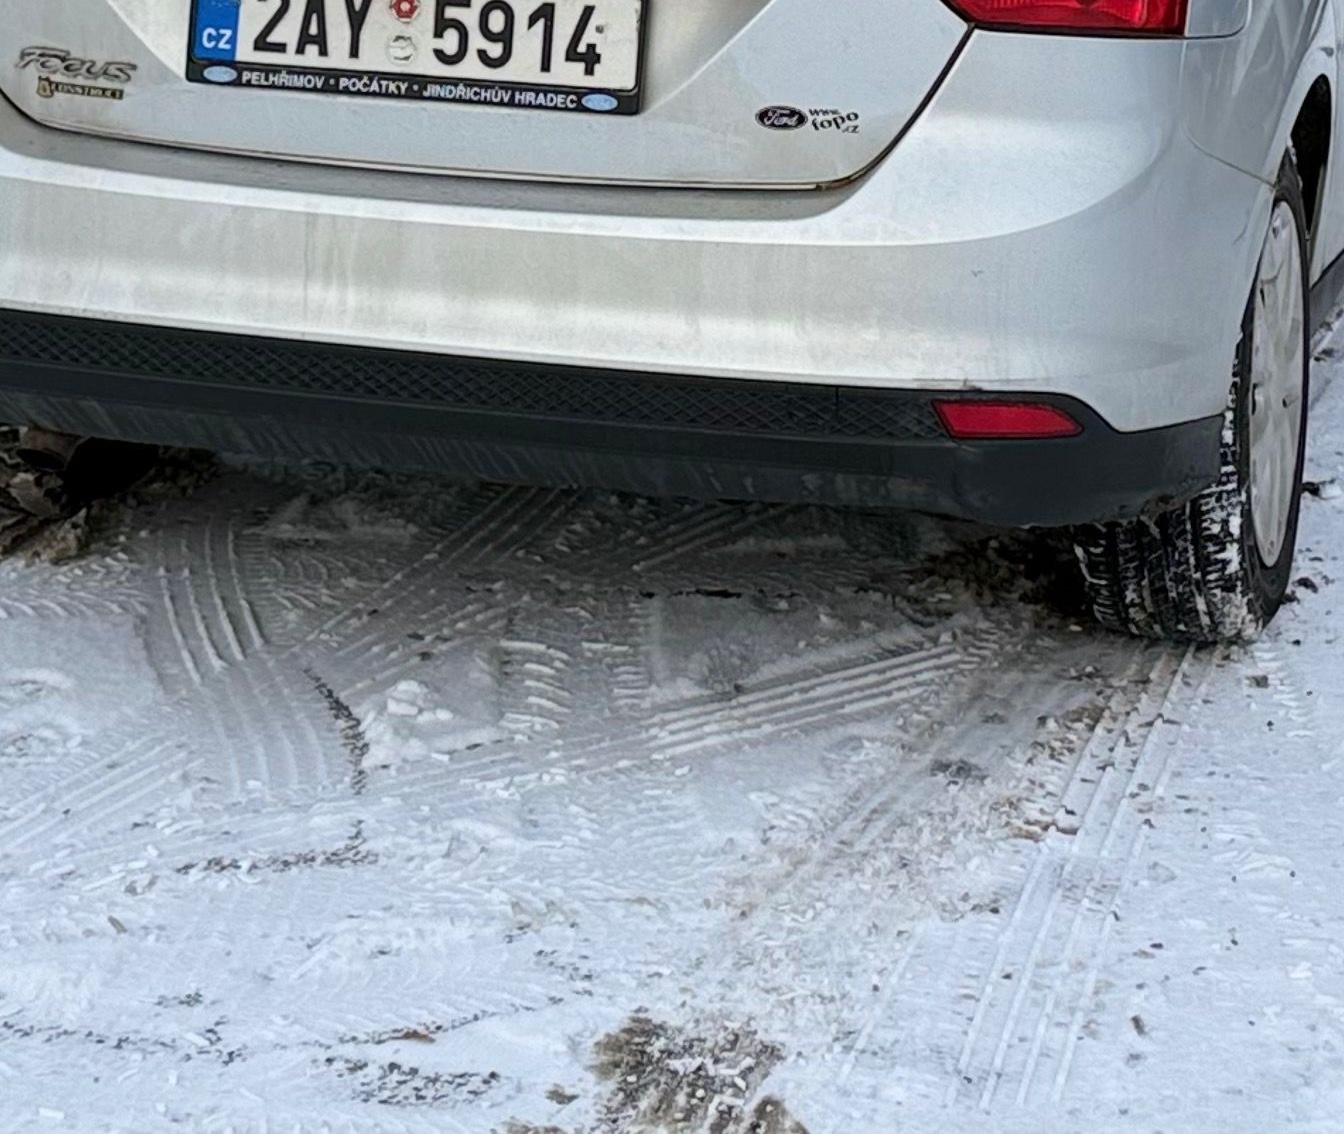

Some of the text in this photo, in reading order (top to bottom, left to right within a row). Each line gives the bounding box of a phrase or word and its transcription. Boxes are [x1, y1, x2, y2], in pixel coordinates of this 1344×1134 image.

[202, 26, 233, 50] CZ
[241, 69, 325, 89] PELHŘIMOV
[338, 75, 409, 95] POČÁTKY
[422, 83, 512, 104] JINDŘICHŮV
[514, 90, 578, 108] HRADEC
[811, 111, 859, 131] fopo
